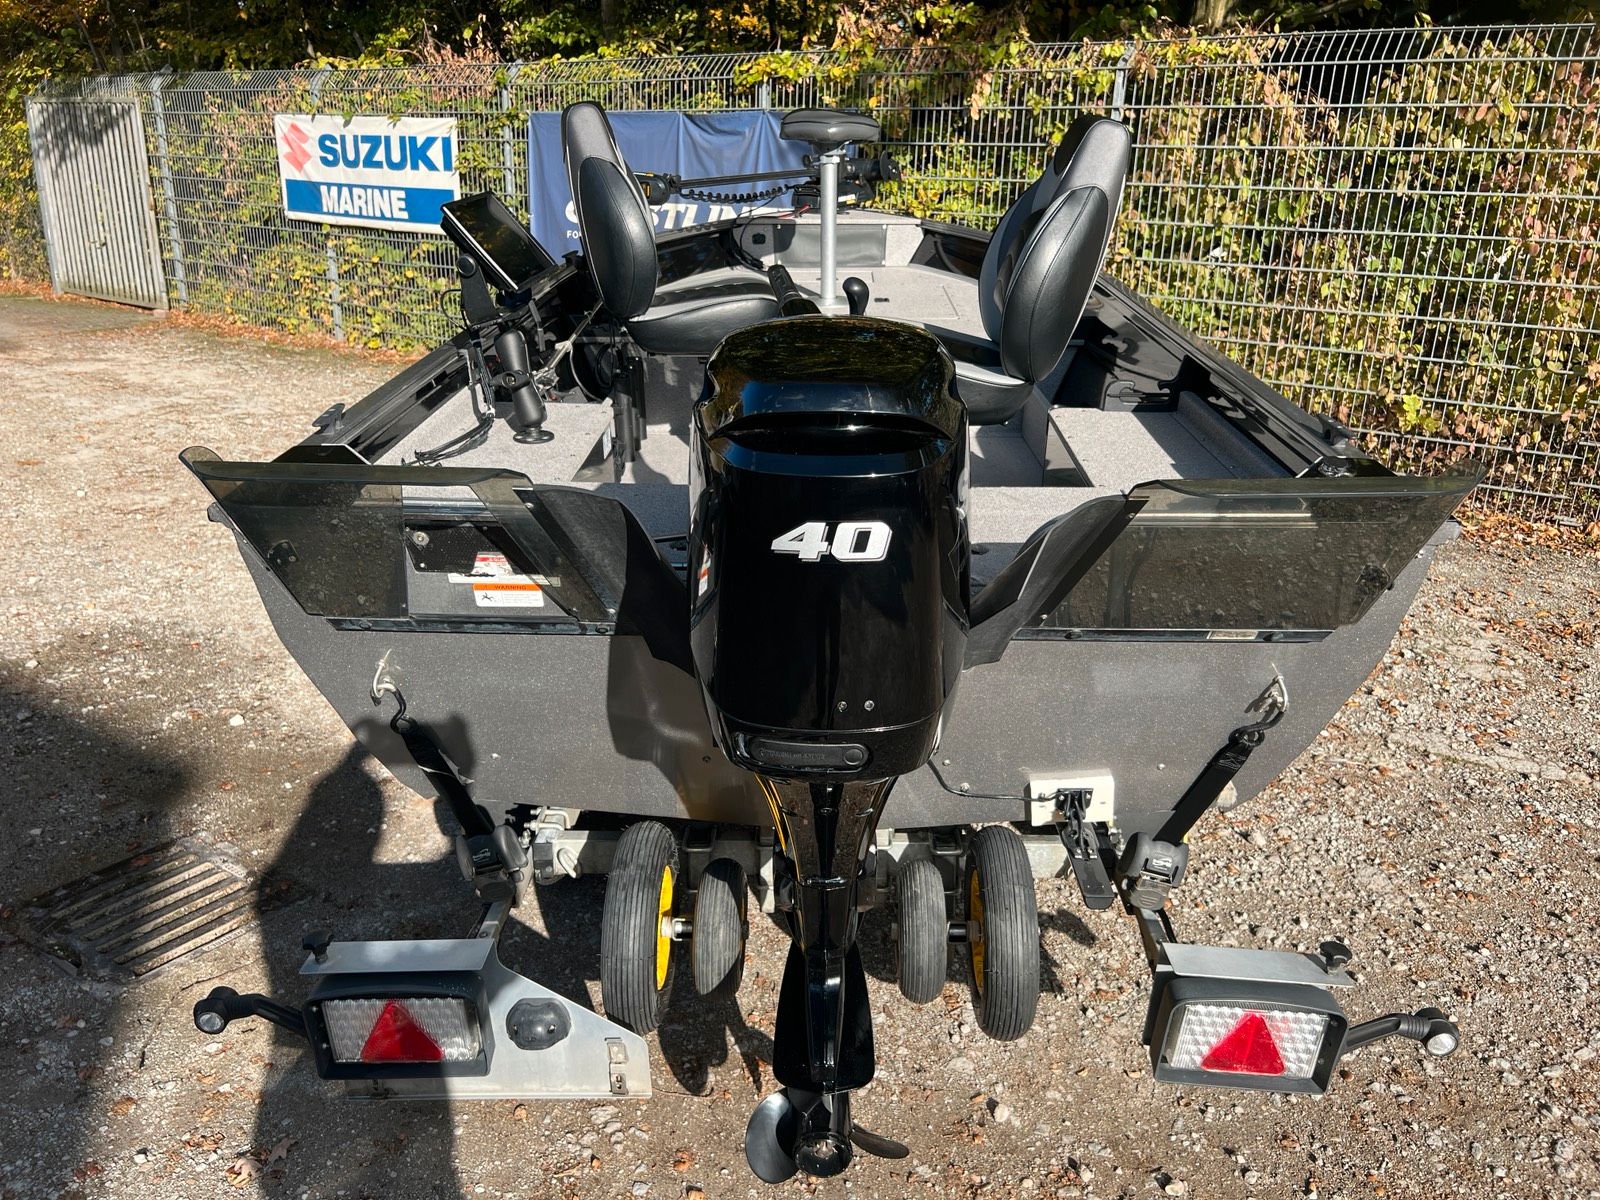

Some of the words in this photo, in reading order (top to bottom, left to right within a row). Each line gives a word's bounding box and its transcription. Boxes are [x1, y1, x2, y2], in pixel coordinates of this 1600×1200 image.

[317, 133, 454, 173] SUZUKI
[319, 184, 409, 220] MARINE
[566, 230, 582, 239] FO
[770, 521, 893, 563] 40
